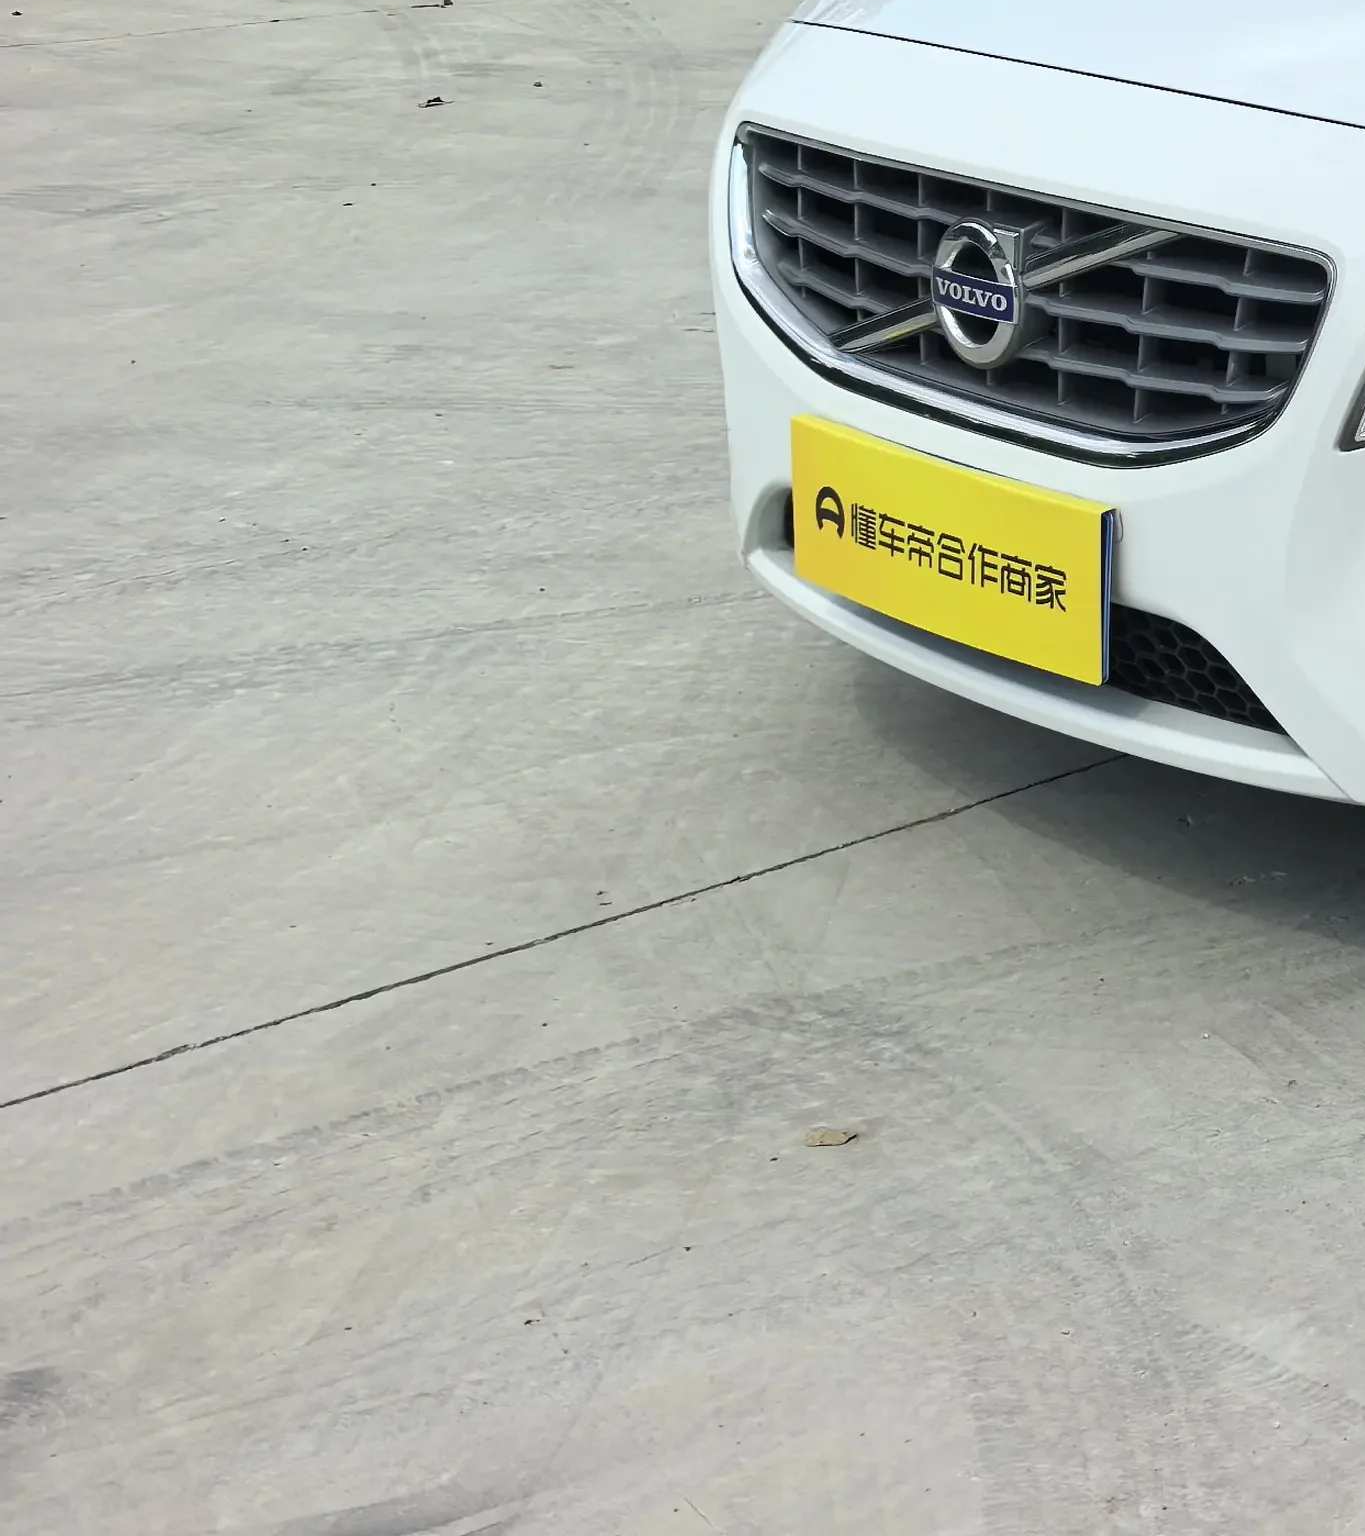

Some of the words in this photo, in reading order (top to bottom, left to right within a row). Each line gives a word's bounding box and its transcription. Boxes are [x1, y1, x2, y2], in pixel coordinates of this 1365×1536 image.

[935, 276, 1008, 312] VOLVO
[850, 502, 1067, 613] 懂车帝合作商家
